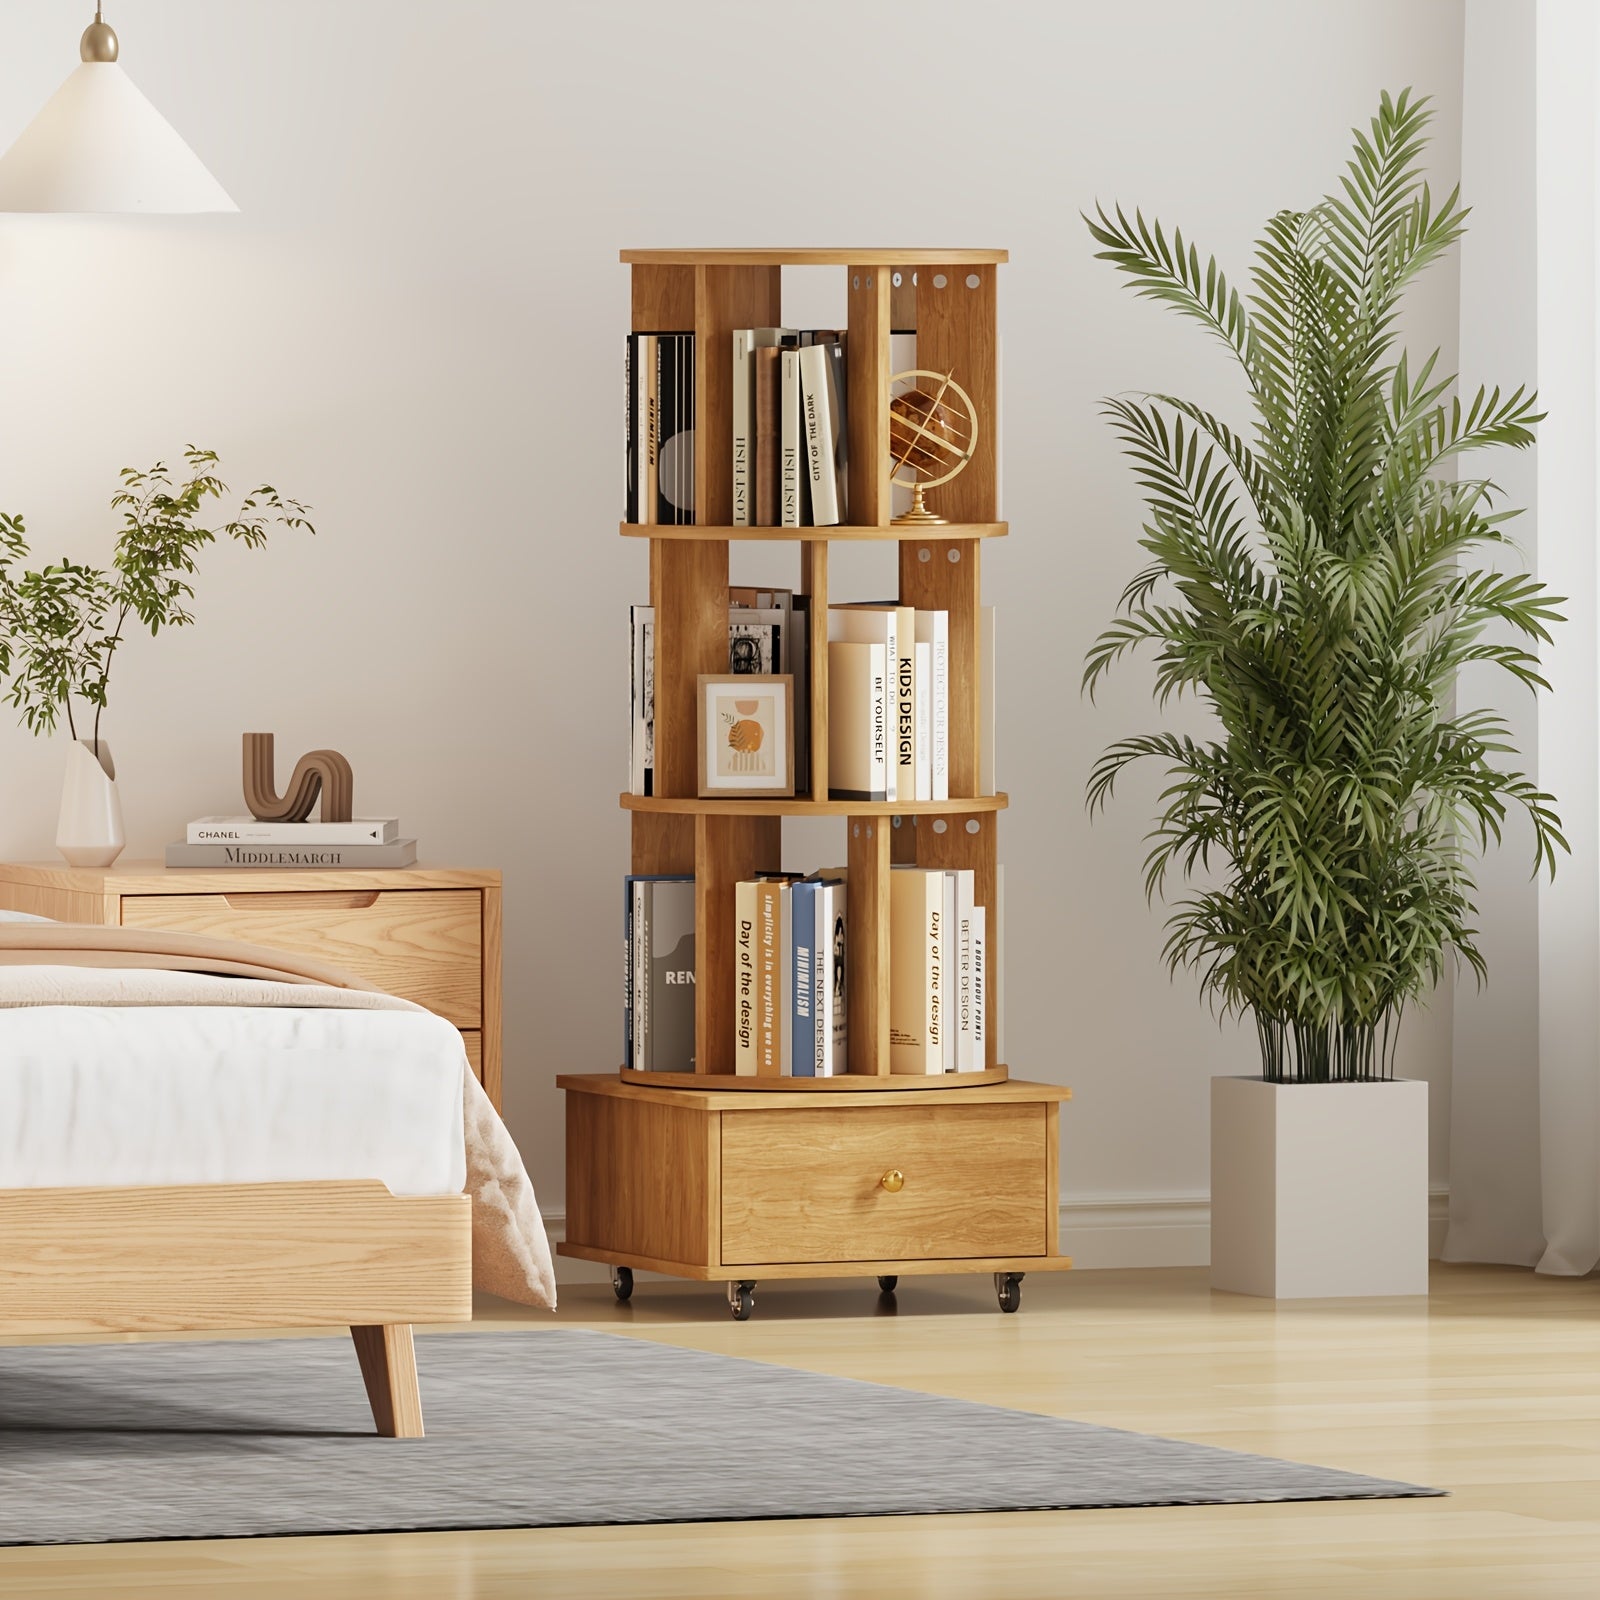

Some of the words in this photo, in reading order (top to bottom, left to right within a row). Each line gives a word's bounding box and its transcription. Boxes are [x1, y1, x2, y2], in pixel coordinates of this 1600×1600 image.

[806, 393, 814, 419] DARK
[808, 421, 816, 440] THE
[735, 437, 746, 474] FISH
[784, 447, 795, 480] FISH
[811, 444, 818, 457] OF
[812, 459, 820, 481] CITY
[735, 478, 746, 521] LOST
[784, 482, 795, 523] LOST
[874, 676, 884, 692] BE
[889, 672, 896, 684] TO
[900, 658, 912, 698] KIDS
[936, 641, 944, 698] PROTECT
[889, 690, 896, 705] DO
[936, 700, 944, 729] OUR
[874, 697, 884, 764] YOURSELF
[900, 702, 912, 766] DESIGN
[936, 731, 944, 776] DESIGN
[198, 831, 240, 839] CHANEL
[739, 920, 752, 949] Day
[762, 894, 773, 946] simplicity
[929, 911, 939, 941] Day
[764, 949, 773, 958] is
[931, 945, 940, 960] of
[961, 919, 969, 971] BETTER
[741, 952, 753, 968] of
[764, 962, 774, 971] in
[816, 951, 824, 973] THE
[740, 971, 753, 996] the
[797, 946, 809, 1017] MINIMALISM
[931, 965, 940, 990] the
[762, 973, 774, 1029] everything
[816, 979, 824, 1012] NEXT
[961, 976, 969, 1031] DESIGN
[739, 1000, 753, 1049] design
[929, 995, 940, 1045] design
[764, 1031, 774, 1045] we
[816, 1018, 824, 1069] DESIGN
[764, 1048, 773, 1066] see
